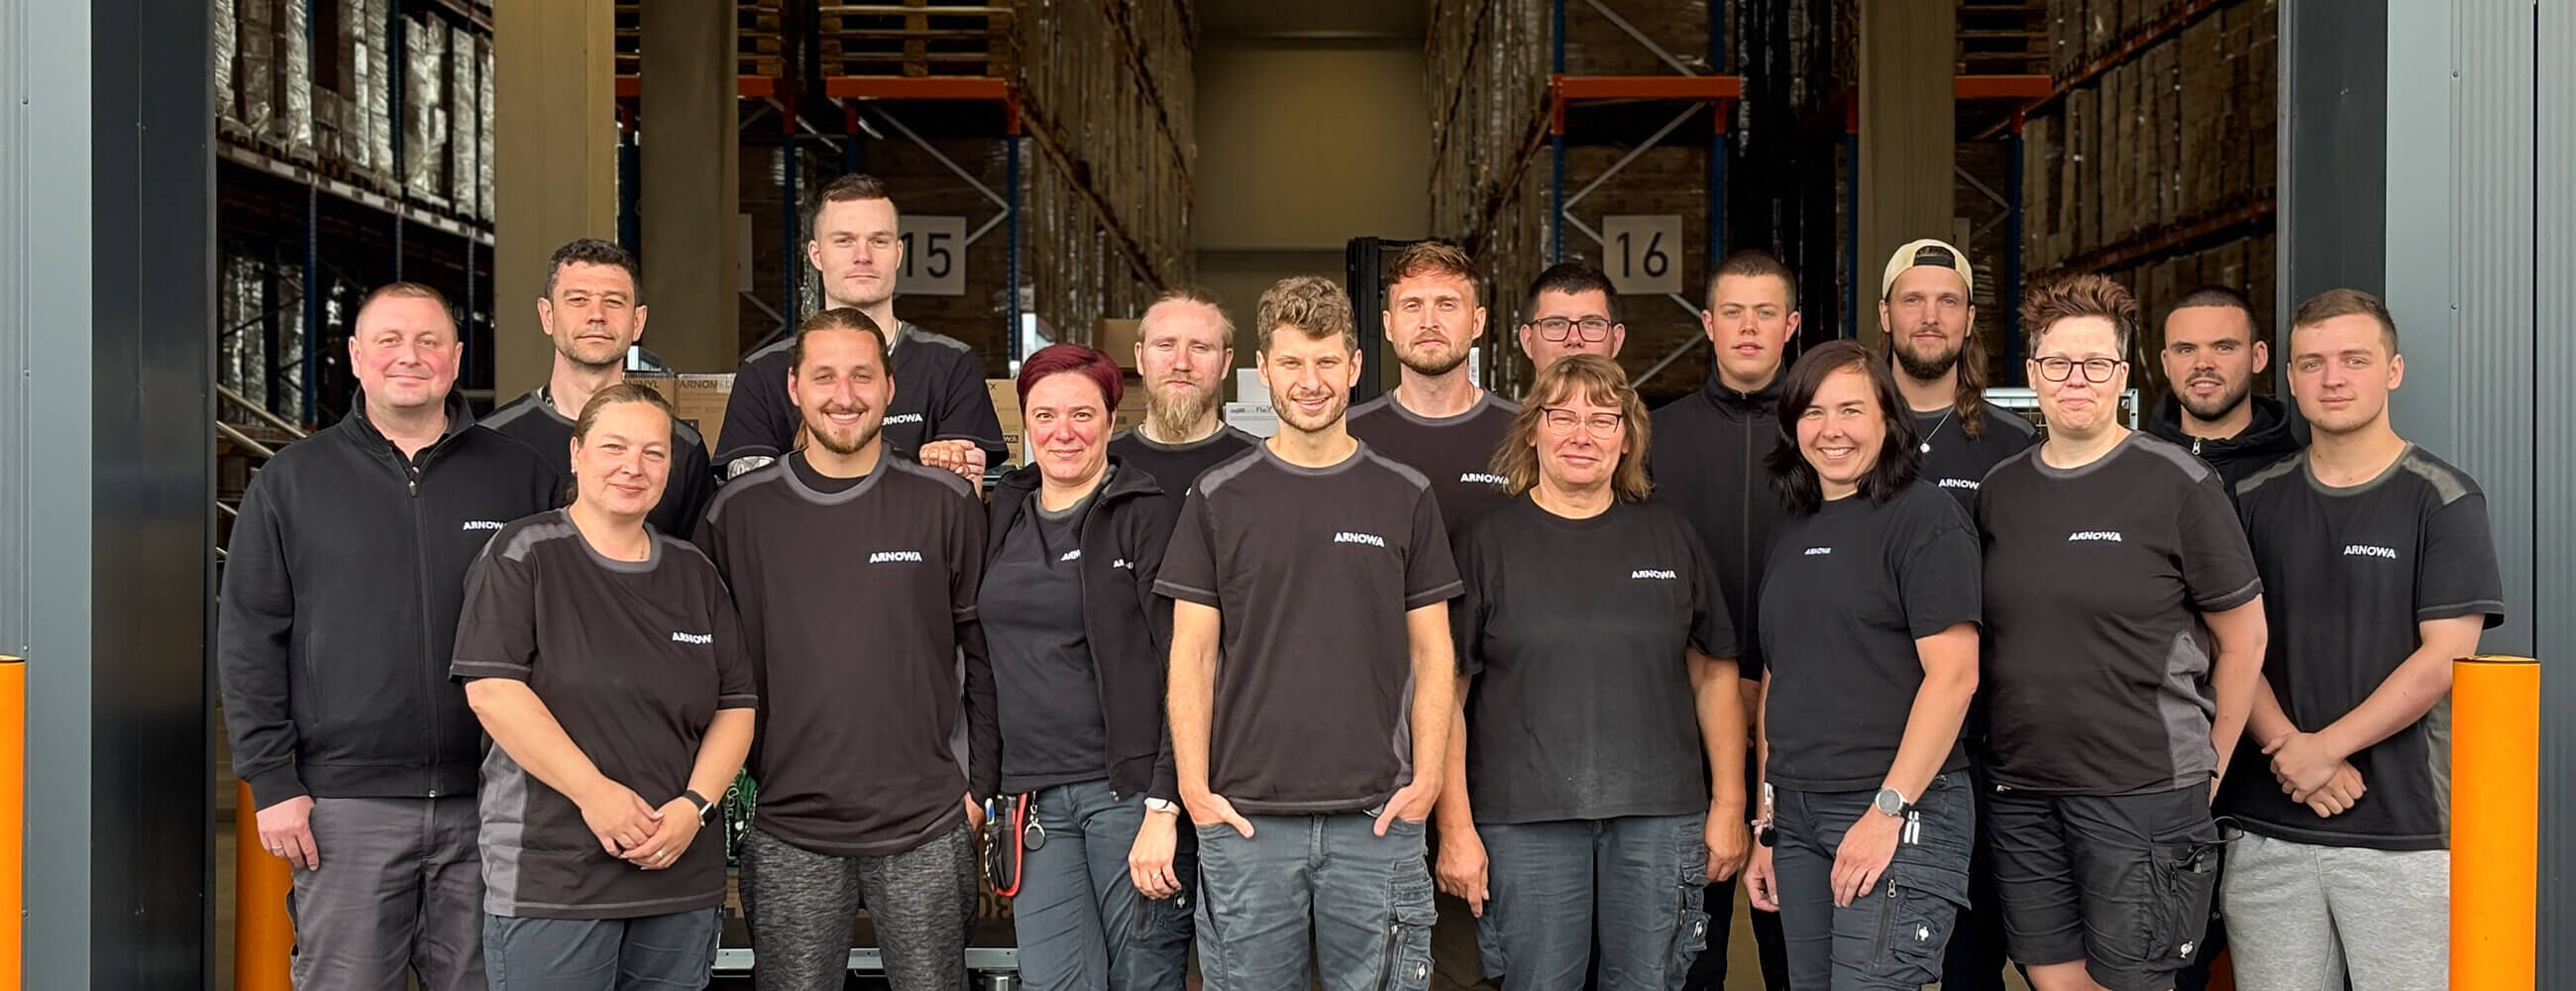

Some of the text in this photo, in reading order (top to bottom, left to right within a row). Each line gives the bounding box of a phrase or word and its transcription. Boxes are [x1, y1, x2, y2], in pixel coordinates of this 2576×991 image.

[901, 232, 951, 278] 15
[1616, 231, 1668, 278] 16
[882, 413, 923, 426] RNOWA
[1938, 479, 1980, 490] ARNOW
[463, 520, 507, 531] ARNOW
[1334, 532, 1385, 548] ARNOWA
[2068, 531, 2122, 542] ARNOWA
[869, 551, 922, 564] ARNOWA
[2343, 545, 2397, 559] ARNOWA
[1631, 570, 1677, 580] ARNOWA
[672, 631, 713, 644] ARNOW
